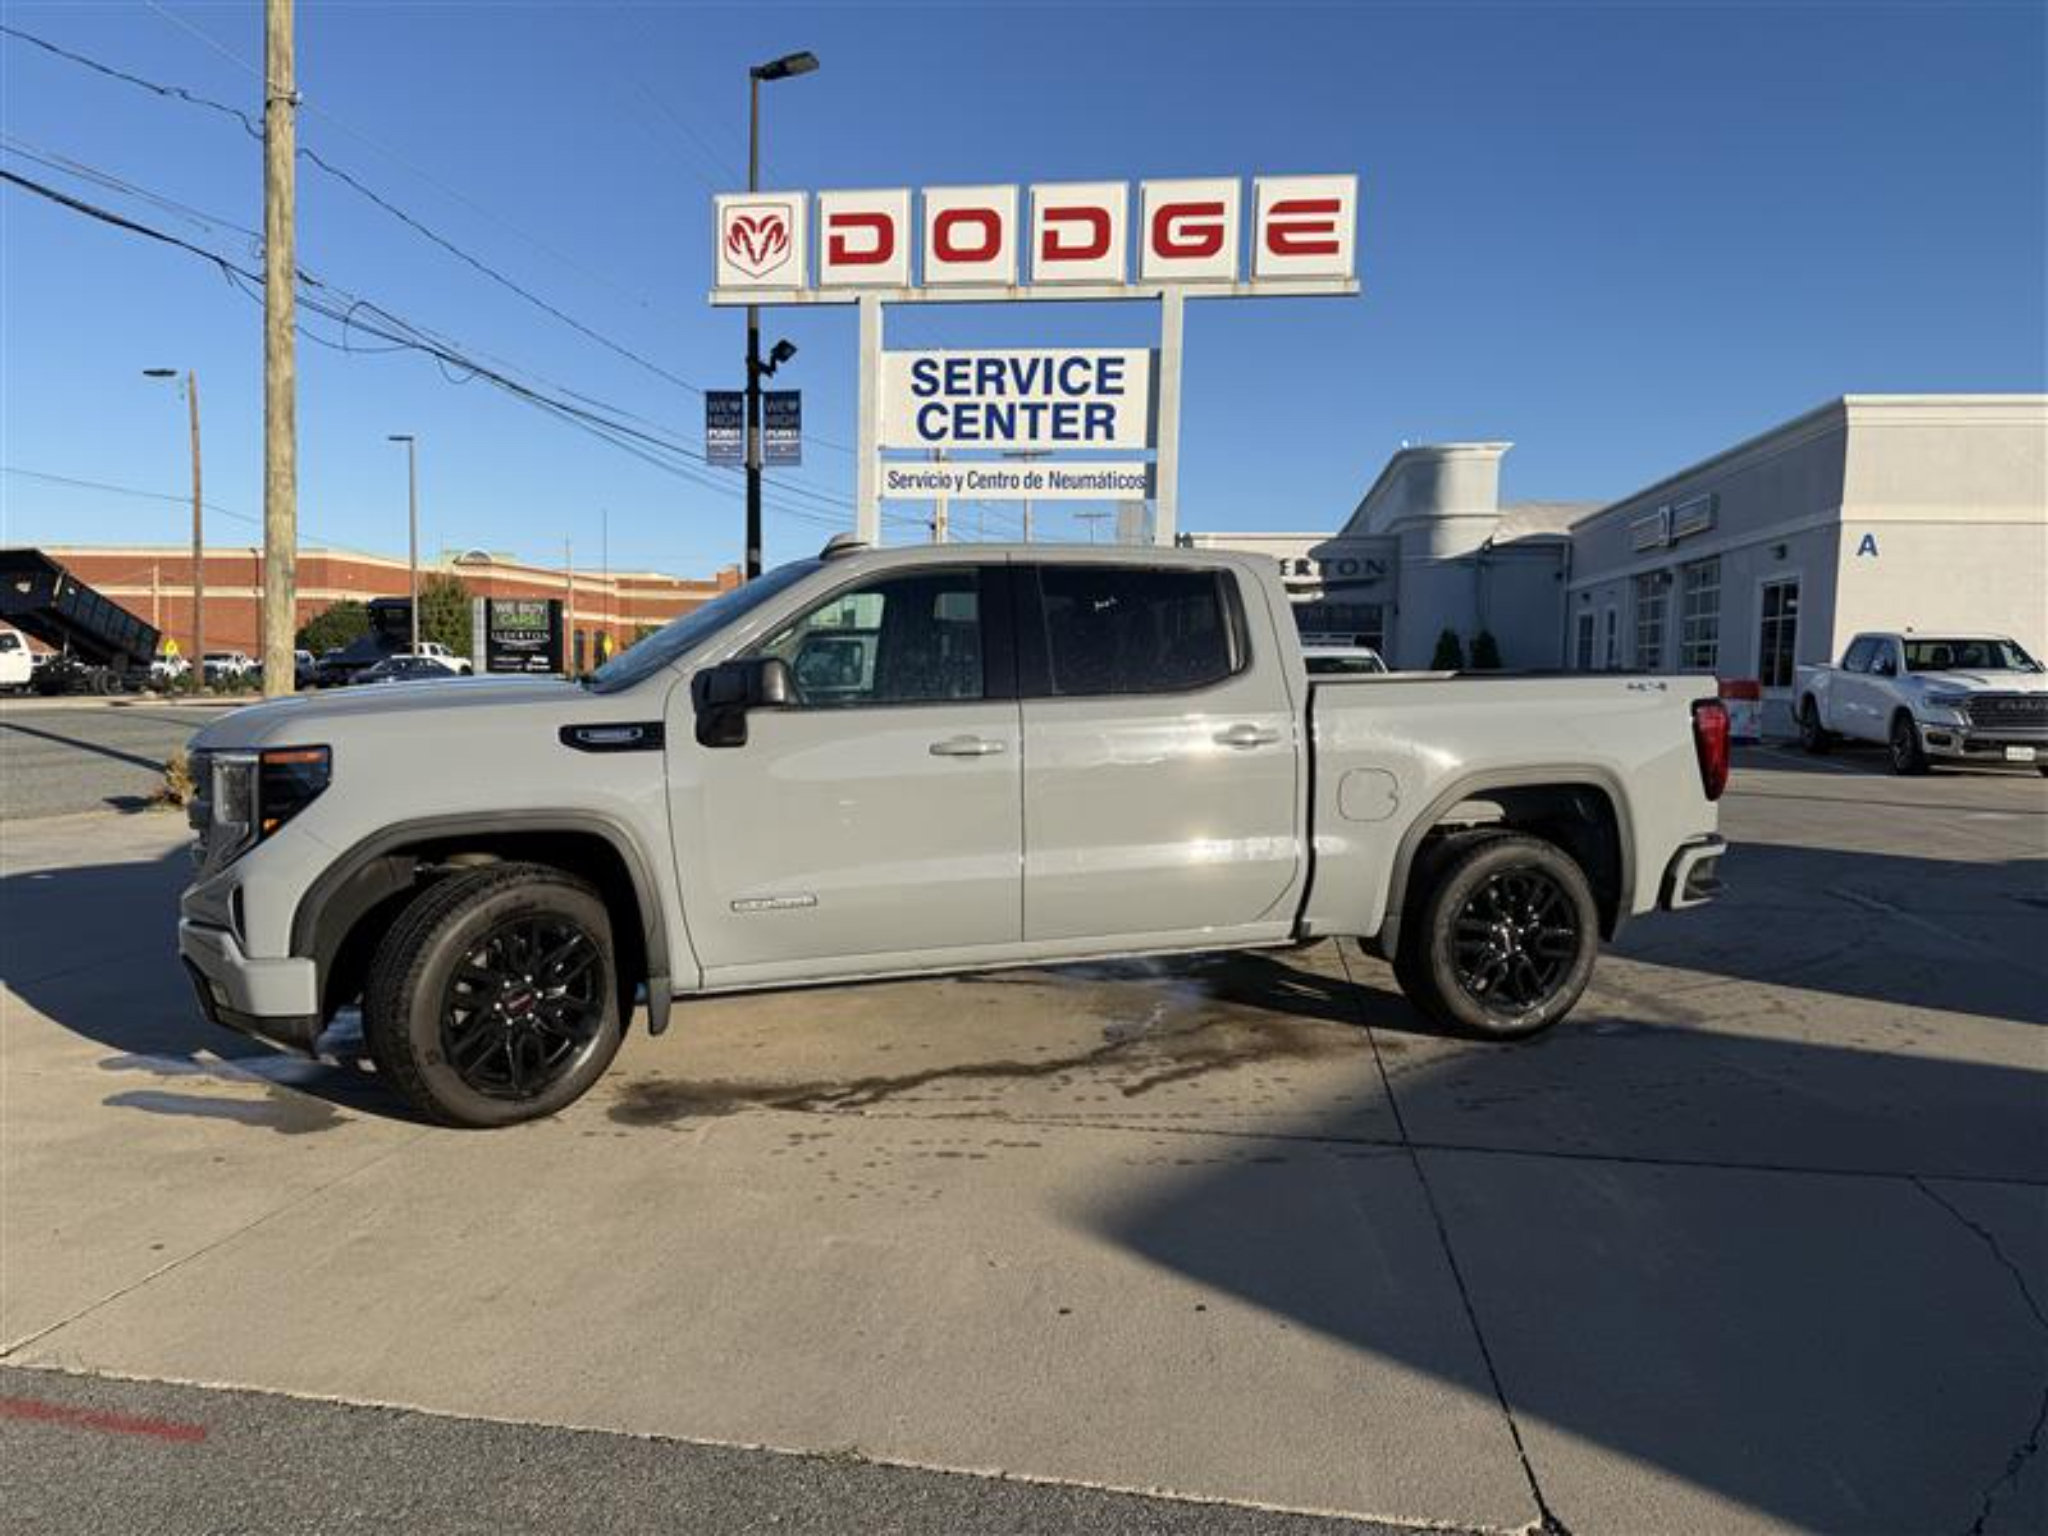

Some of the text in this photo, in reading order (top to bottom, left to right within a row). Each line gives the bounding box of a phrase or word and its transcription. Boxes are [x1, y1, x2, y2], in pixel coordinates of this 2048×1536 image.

[828, 198, 1341, 266] DODGE
[911, 356, 1125, 397] SERVICE
[916, 402, 1117, 441] CENTER
[887, 469, 1148, 492] Servicio y Centro de Neumáticos
[1857, 533, 1878, 556] A
